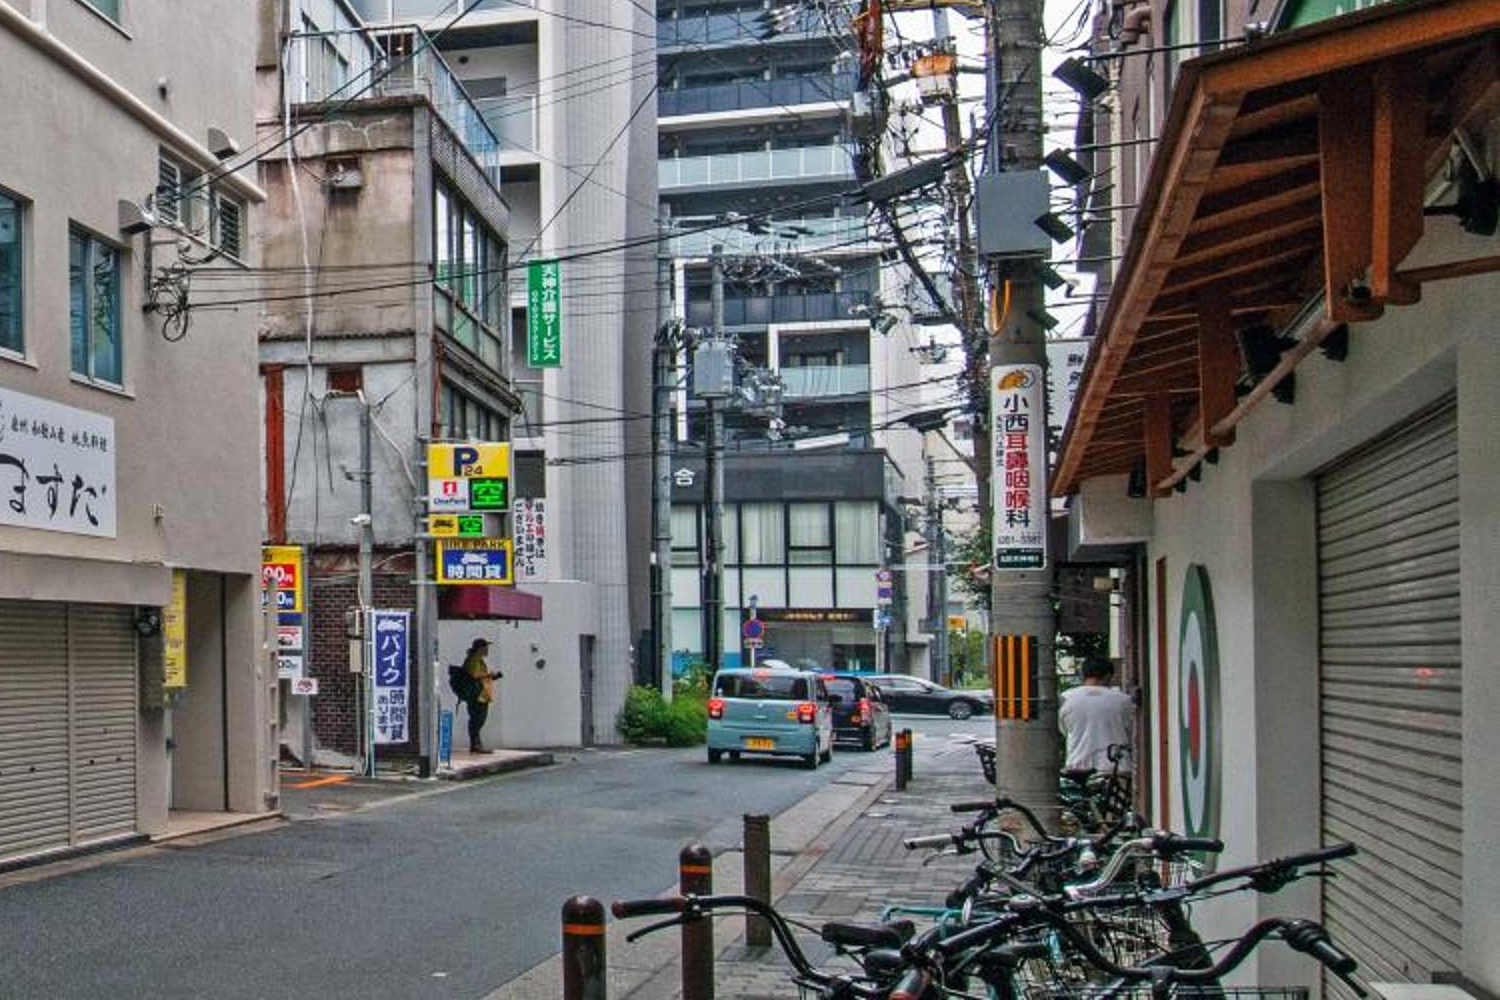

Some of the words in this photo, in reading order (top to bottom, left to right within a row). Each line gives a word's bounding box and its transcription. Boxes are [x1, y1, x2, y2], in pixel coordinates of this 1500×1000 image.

[453, 447, 479, 477] P
[1003, 393, 1031, 529] 小西耳鼻咽喉科
[473, 480, 505, 506] 空
[447, 563, 502, 580] 時間貸
[381, 634, 401, 684] バイク
[378, 695, 389, 735] あります
